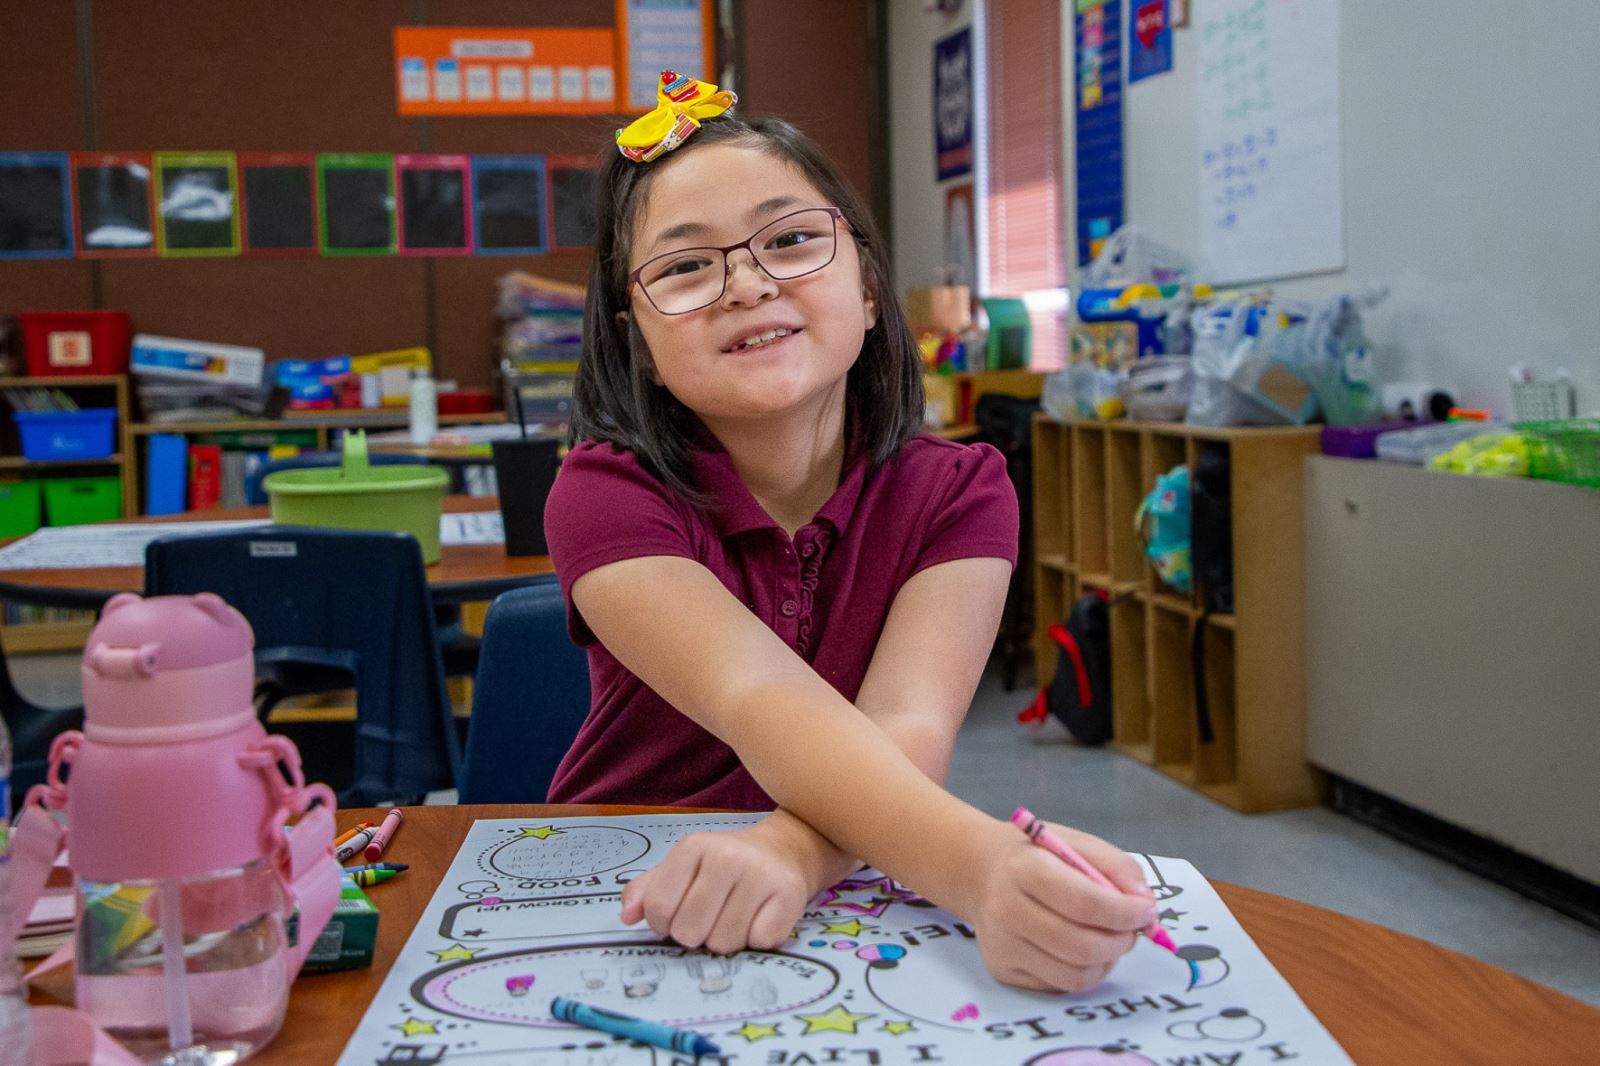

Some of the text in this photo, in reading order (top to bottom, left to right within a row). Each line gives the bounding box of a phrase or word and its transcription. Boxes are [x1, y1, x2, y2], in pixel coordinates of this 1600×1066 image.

[517, 876, 602, 889] FOOD
[476, 904, 511, 913] UP!
[517, 899, 579, 910] GROW
[984, 993, 1203, 1041] THIS IS
[766, 1048, 882, 1066] LIVE
[905, 1043, 944, 1063] I
[1258, 1041, 1301, 1062] I
